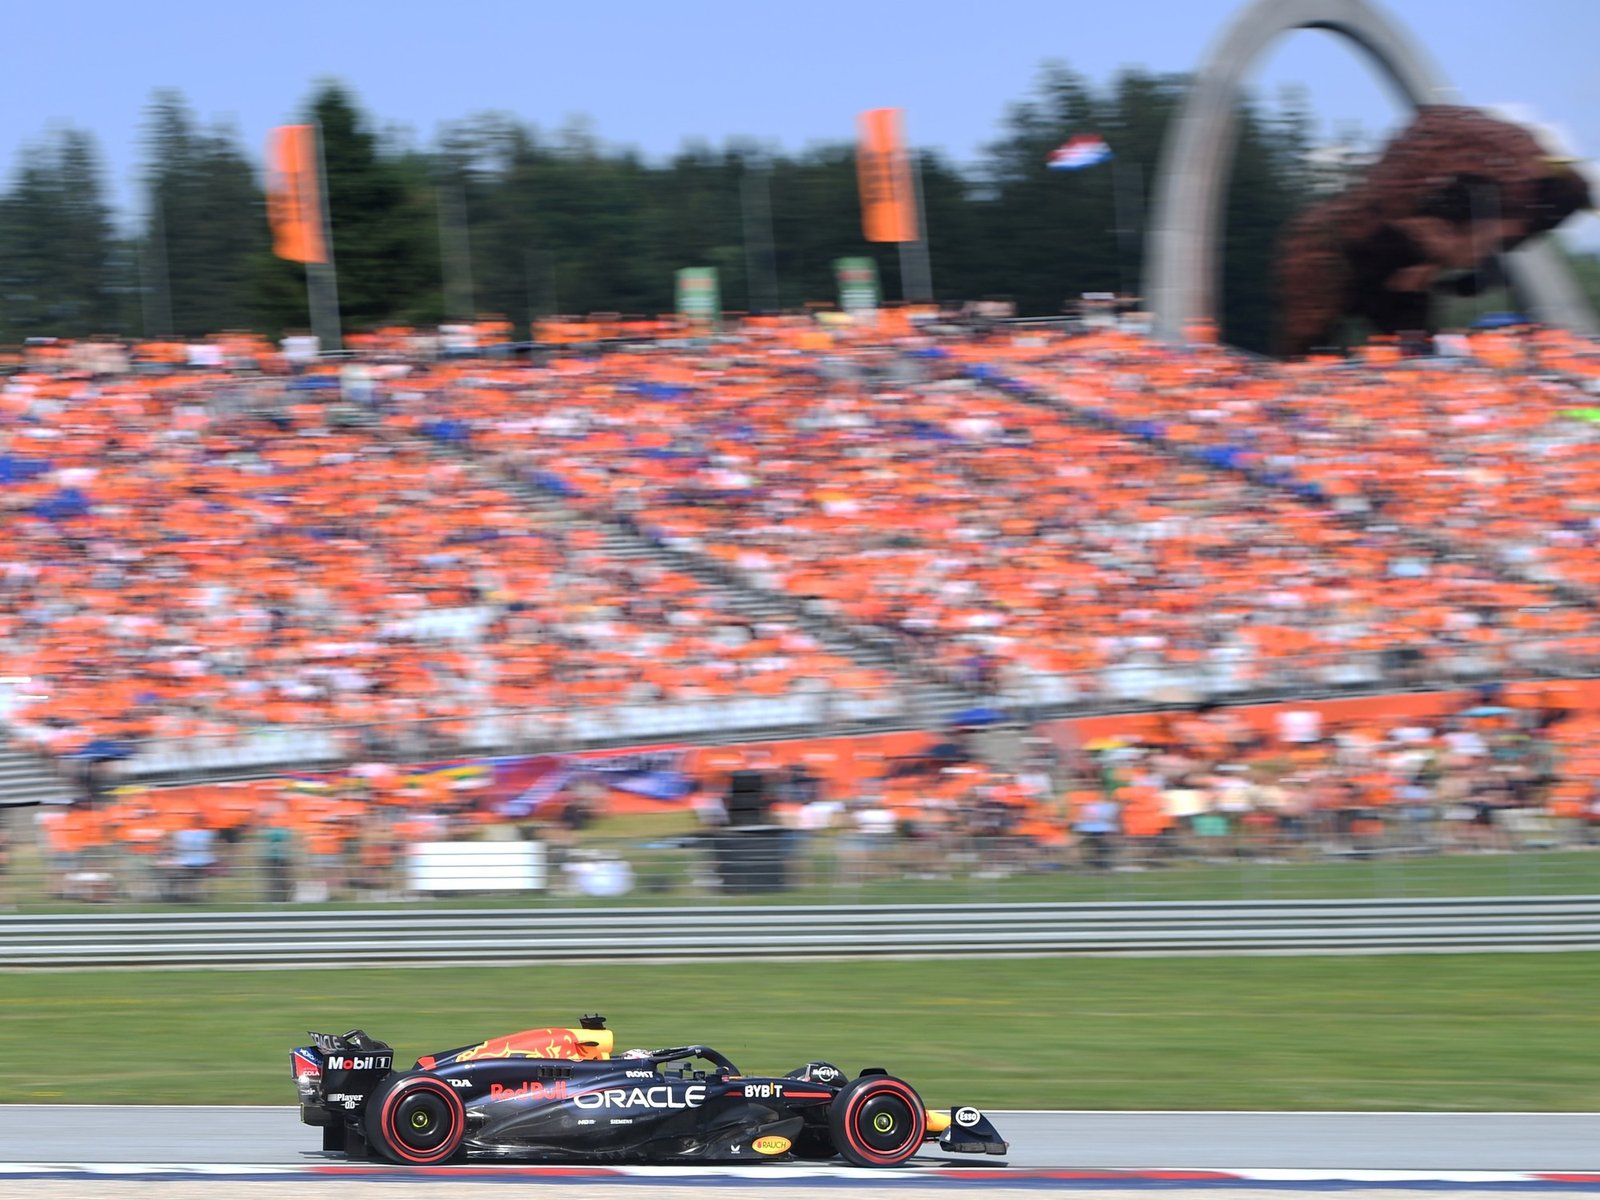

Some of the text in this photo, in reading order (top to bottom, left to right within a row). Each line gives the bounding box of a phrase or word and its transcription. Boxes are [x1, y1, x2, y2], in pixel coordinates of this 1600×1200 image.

[328, 1056, 373, 1070] Mobil
[490, 1080, 568, 1102] Red Bull
[573, 1085, 706, 1109] ORACLE
[744, 1082, 783, 1098] BYBIT
[337, 1093, 364, 1102] Player
[959, 1111, 977, 1121] Esso
[762, 1141, 787, 1149] RAUCH
